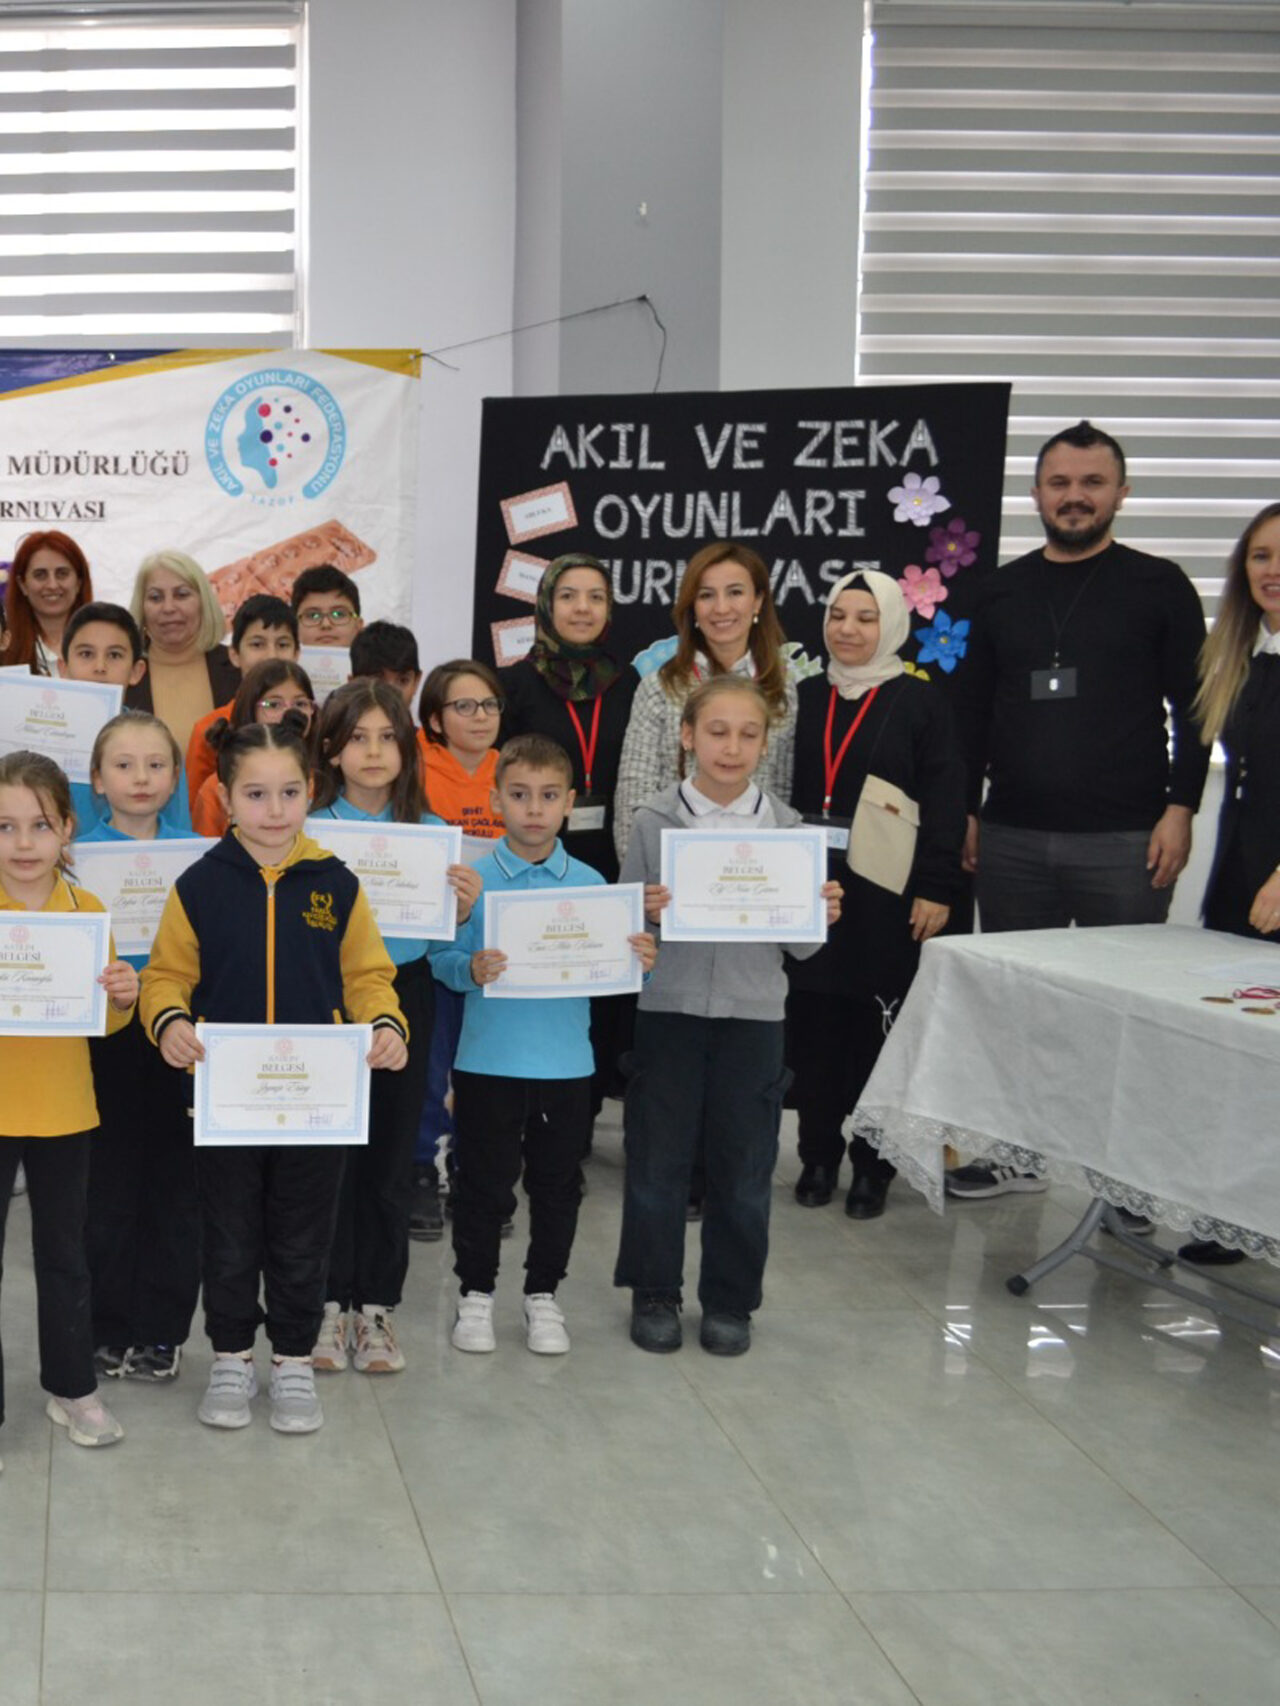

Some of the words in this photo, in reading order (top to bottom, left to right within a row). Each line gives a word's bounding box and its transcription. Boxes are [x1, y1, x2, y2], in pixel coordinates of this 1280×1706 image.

[7, 450, 190, 476] MÜDÜRLÜĞÜ
[207, 441, 219, 458] VE
[539, 423, 666, 470] AKIL
[694, 422, 767, 470] VE
[793, 418, 939, 468] ZEKA
[593, 489, 866, 539] OYUNLARI
